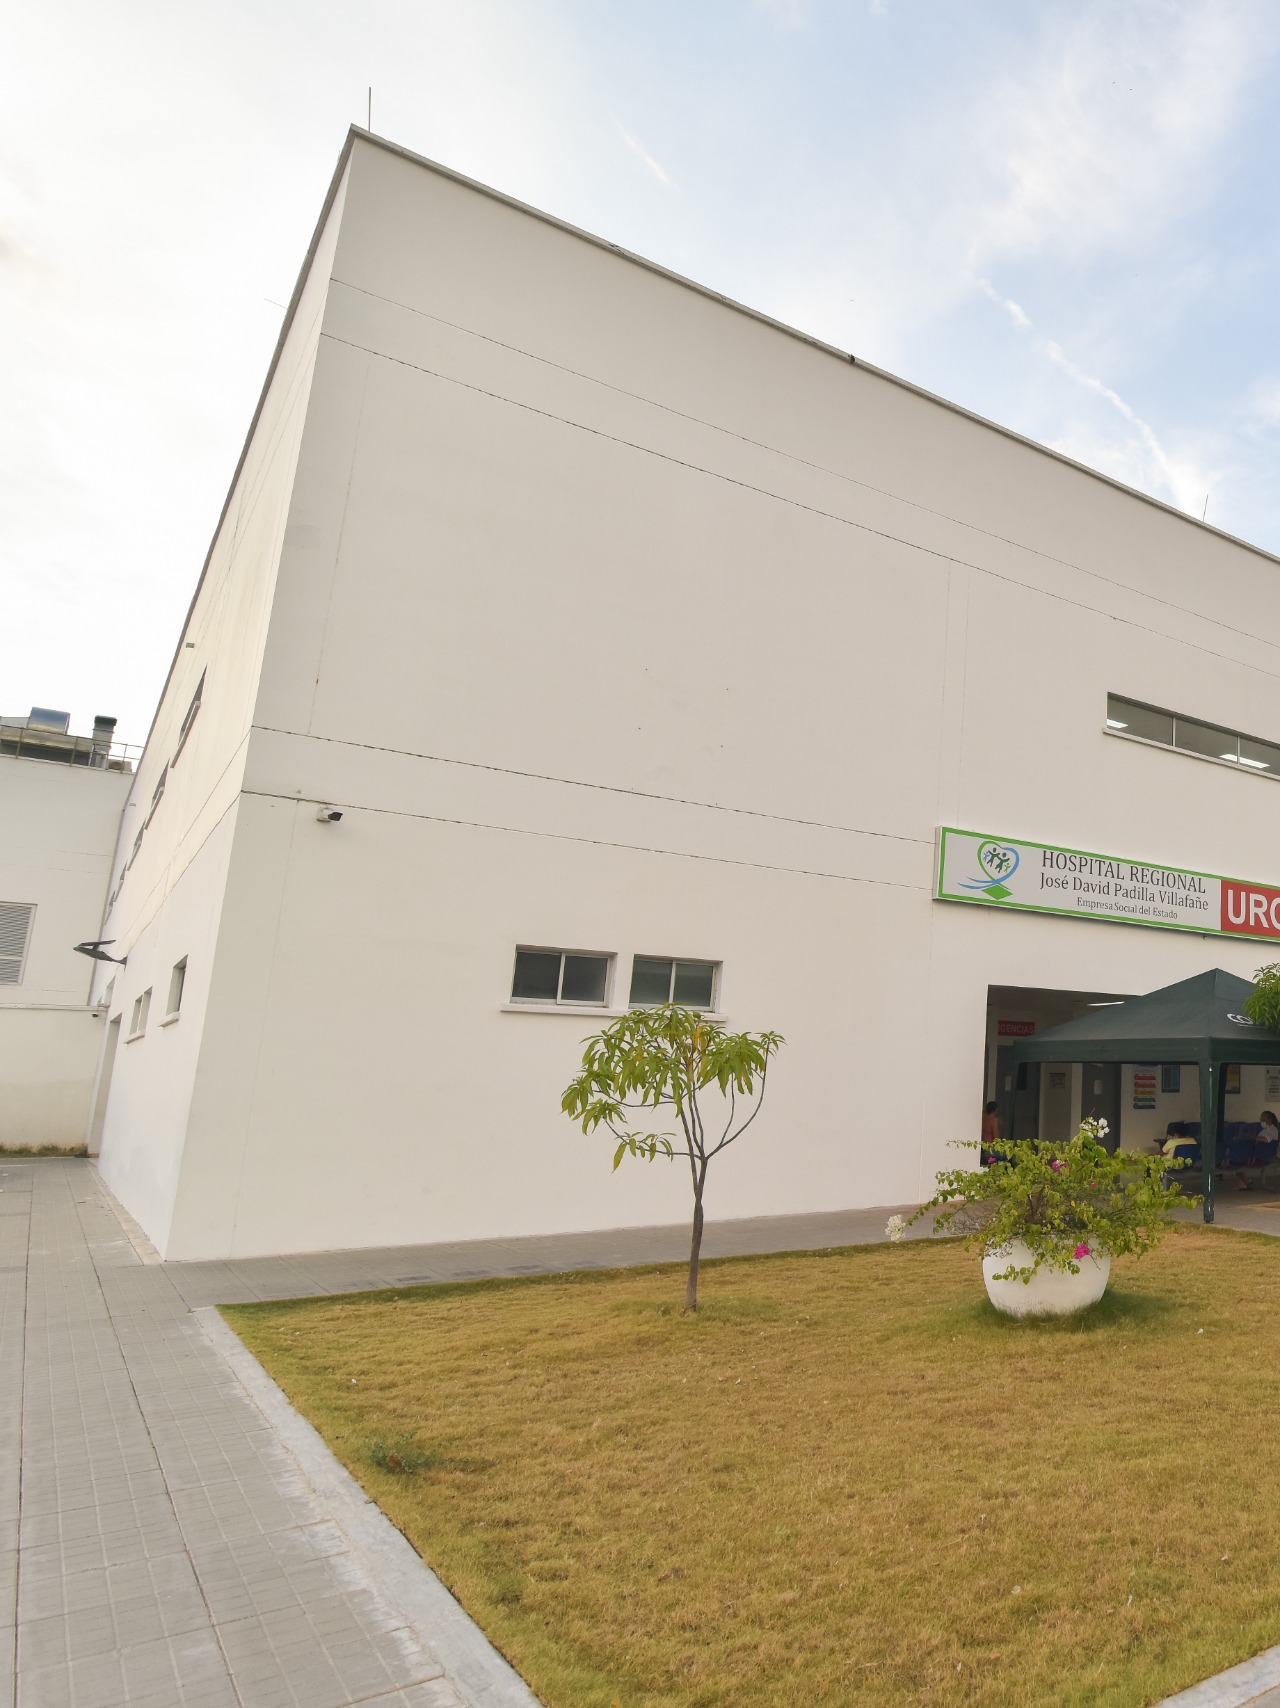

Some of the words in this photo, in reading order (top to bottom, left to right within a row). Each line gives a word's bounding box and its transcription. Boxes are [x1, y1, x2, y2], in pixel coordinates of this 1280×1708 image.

[1040, 872, 1069, 889] José
[1073, 877, 1110, 896] David
[1114, 883, 1155, 903] Padilla
[1158, 890, 1209, 911] Villafañe
[1042, 850, 1125, 880] HOSPITAL
[1130, 865, 1206, 894] REGIONAL
[1077, 897, 1113, 910] Empresa
[1114, 902, 1137, 914] Social
[1138, 906, 1150, 916] del
[1153, 907, 1178, 919] Estado
